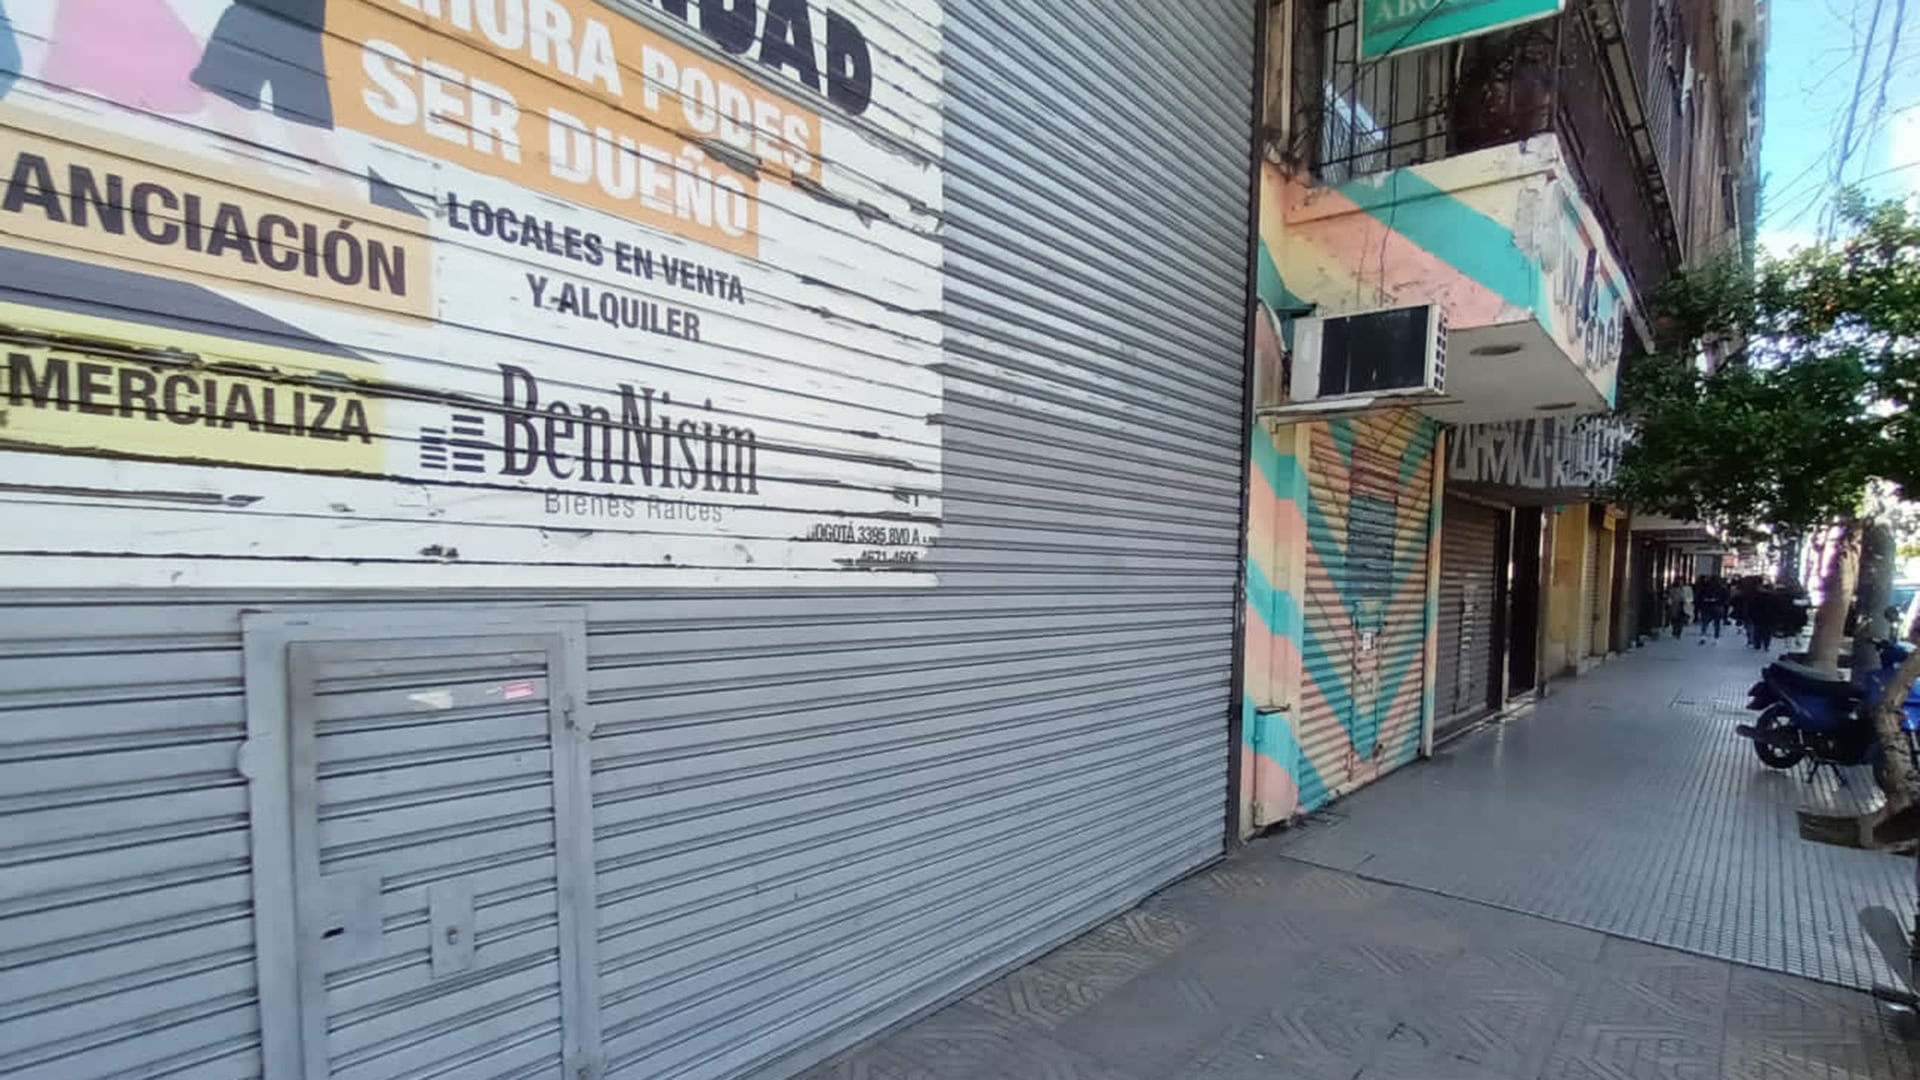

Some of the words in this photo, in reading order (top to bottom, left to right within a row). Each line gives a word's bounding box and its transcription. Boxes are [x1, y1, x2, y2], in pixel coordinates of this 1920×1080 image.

[361, 39, 521, 164] SER
[548, 107, 748, 238] DUEÑO
[397, 0, 623, 97] ORA
[641, 44, 812, 175] PODES
[2, 151, 407, 297] ANCIACIÓN
[446, 191, 602, 266] LOCALES
[614, 241, 653, 280] EN
[661, 253, 745, 305] VENTA
[526, 272, 546, 309] Y
[557, 282, 701, 342] ALQUILER
[7, 352, 372, 445] MERCIALIZA
[498, 363, 759, 496] BenNisim
[545, 489, 635, 519] Bienes
